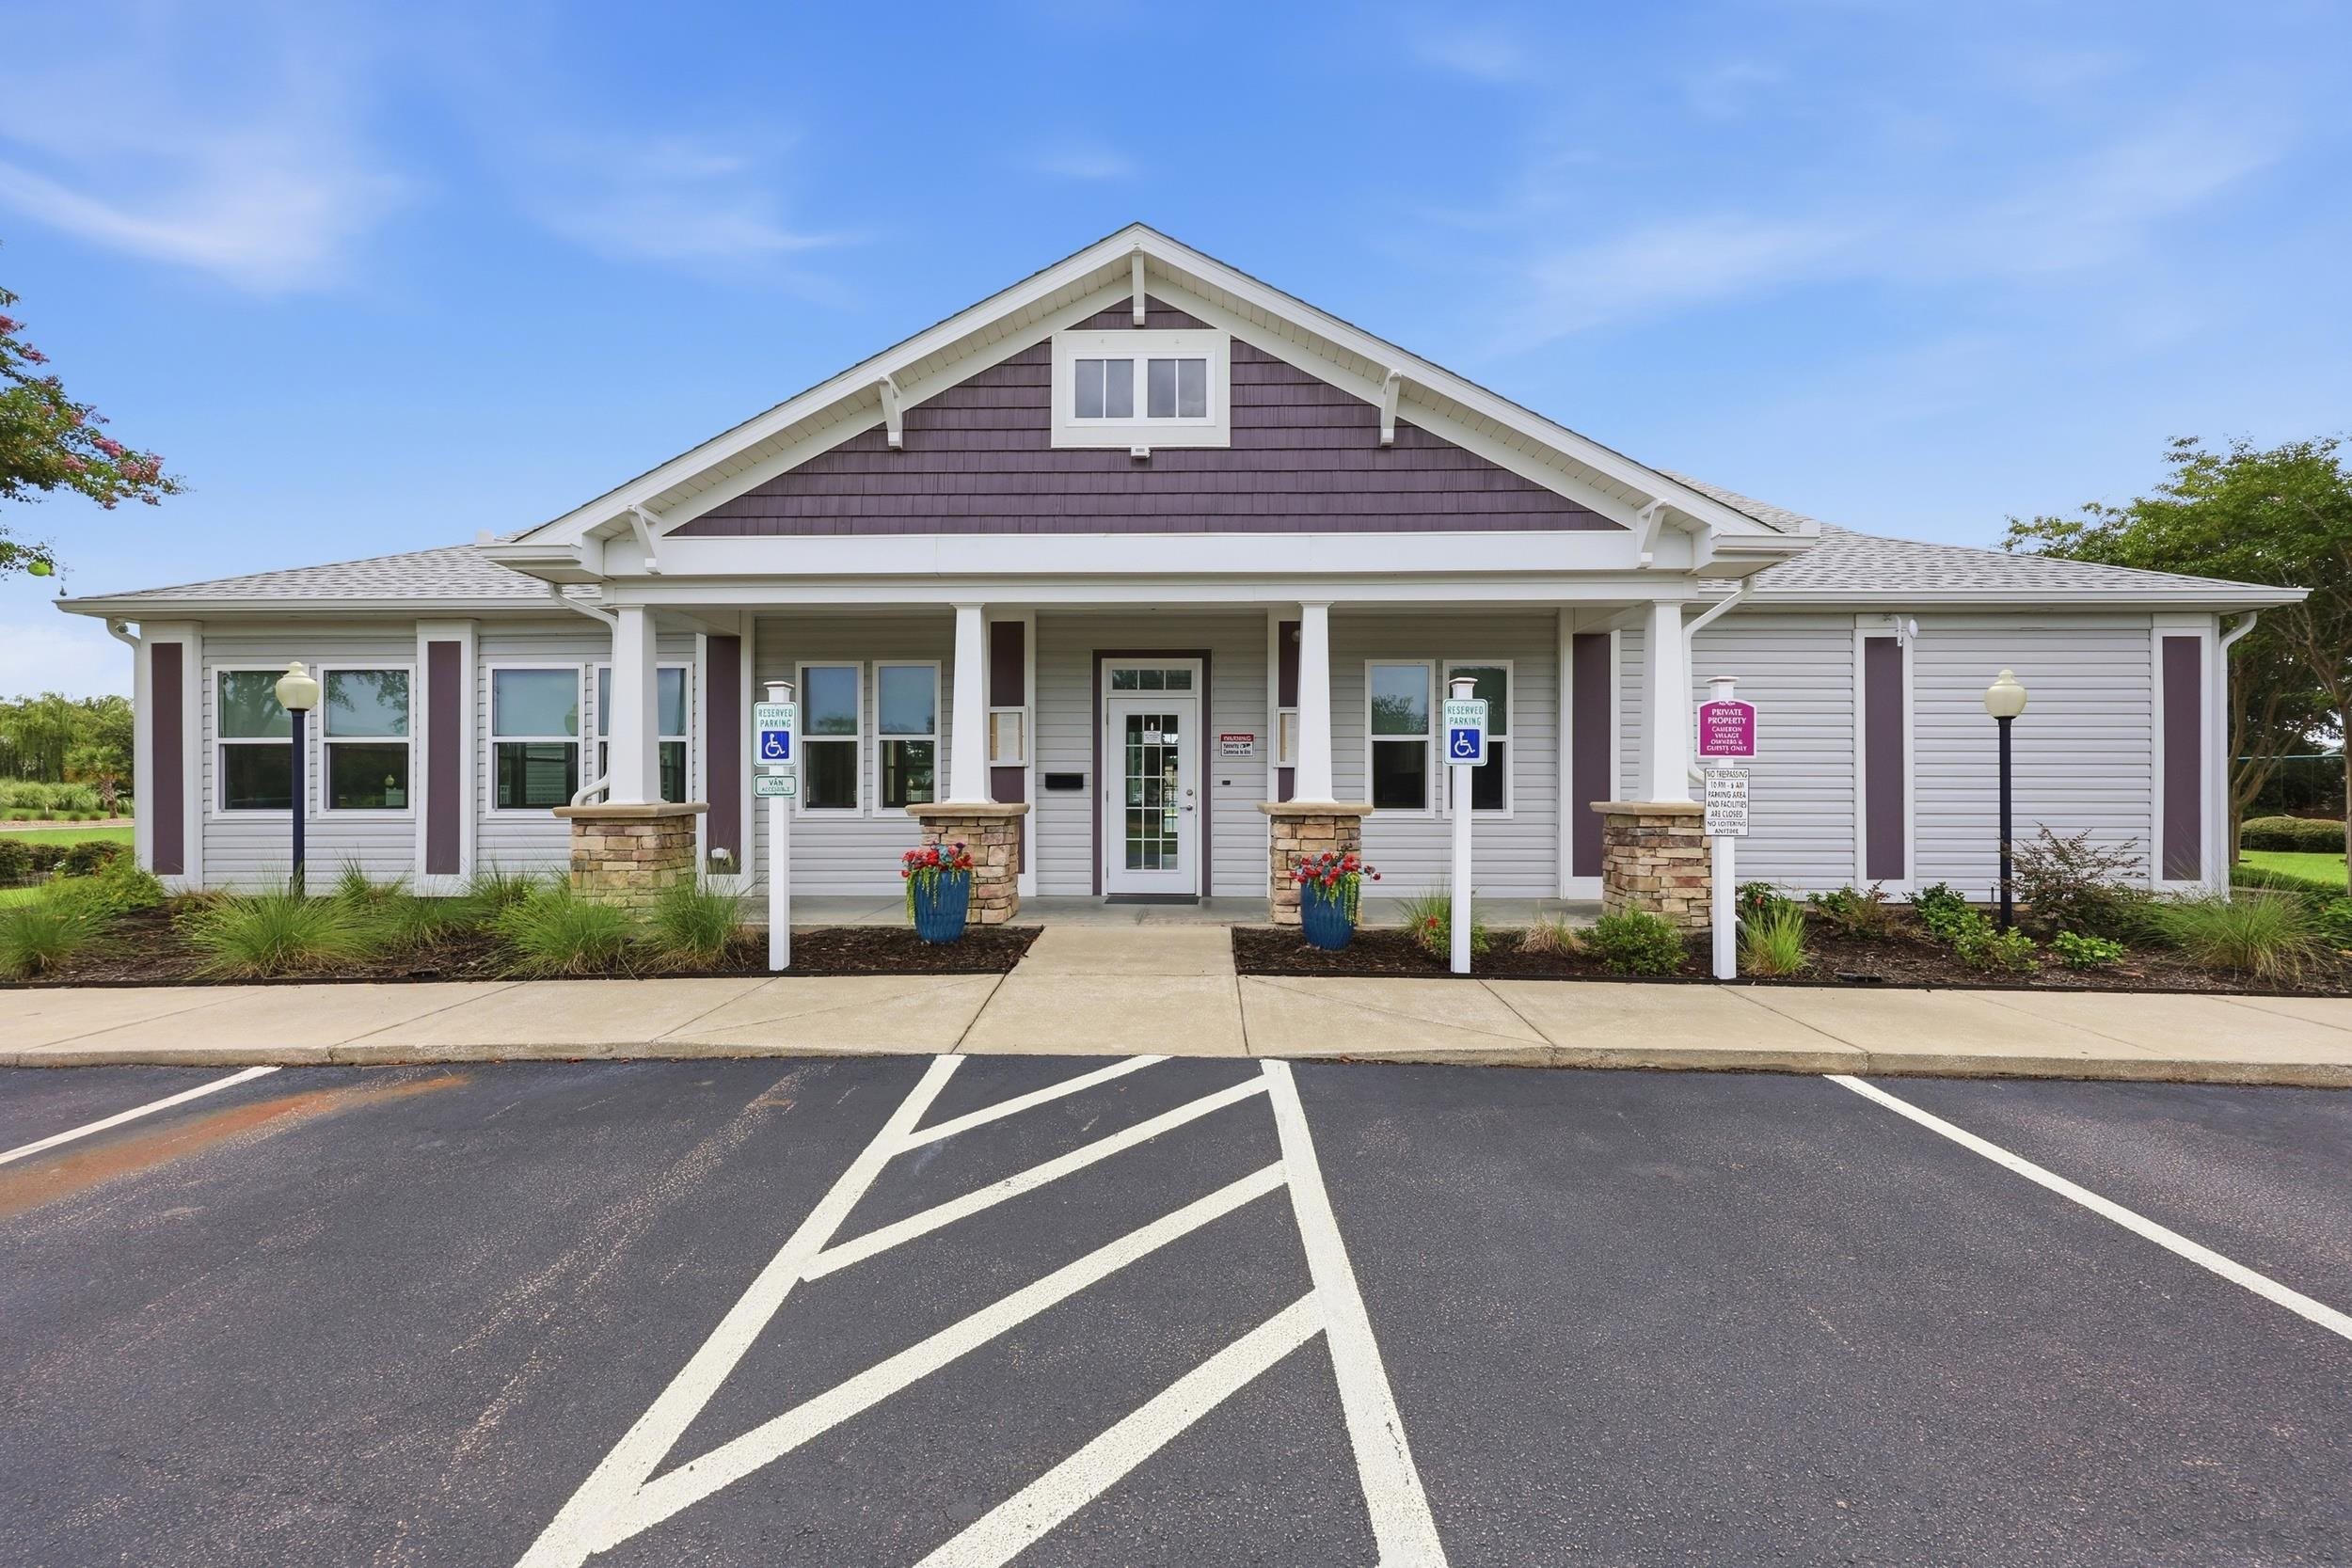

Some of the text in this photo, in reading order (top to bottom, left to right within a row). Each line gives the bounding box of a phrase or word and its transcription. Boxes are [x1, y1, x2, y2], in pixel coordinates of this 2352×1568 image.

[758, 708, 793, 717] RESERVED
[1447, 706, 1484, 715] RESERVED
[1450, 717, 1482, 725] PARKING
[1710, 781, 1717, 789] 10
[1721, 800, 1747, 809] FACILITIES
[1722, 810, 1744, 818] CLOSED
